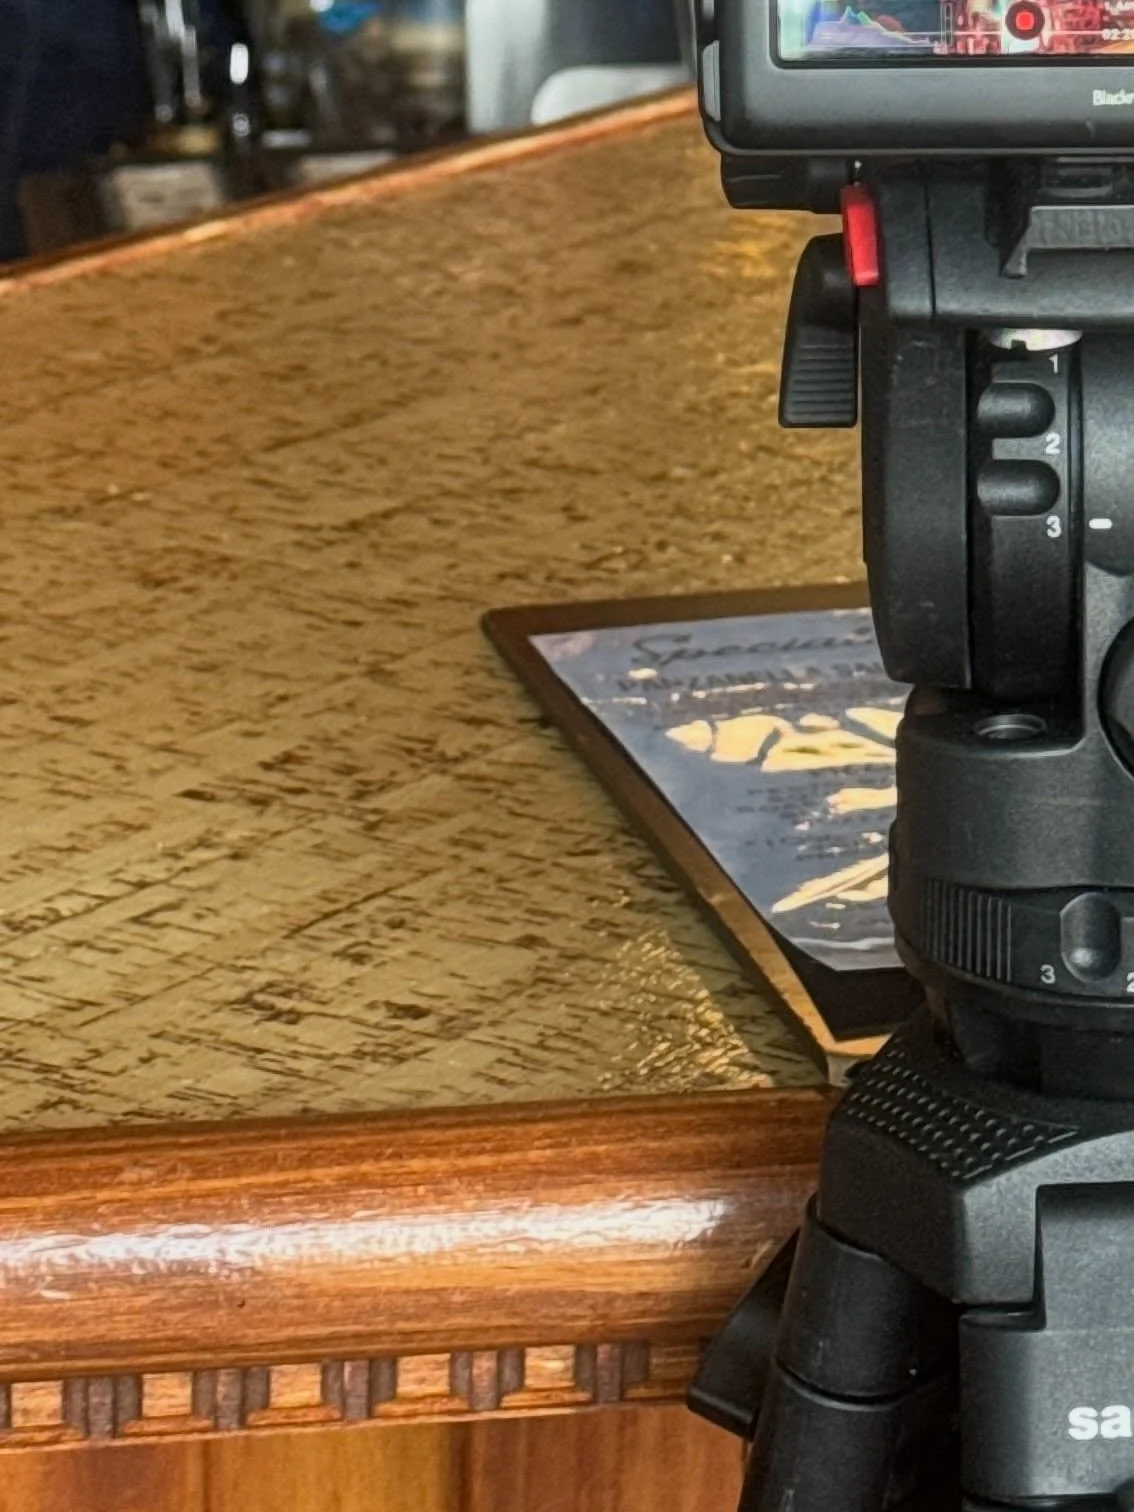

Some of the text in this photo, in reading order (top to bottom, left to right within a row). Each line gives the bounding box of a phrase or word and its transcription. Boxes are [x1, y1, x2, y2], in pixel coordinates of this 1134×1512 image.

[1049, 354, 1060, 374] 1
[1045, 432, 1061, 455] 2
[1046, 515, 1062, 538] 3
[1039, 964, 1056, 984] 3
